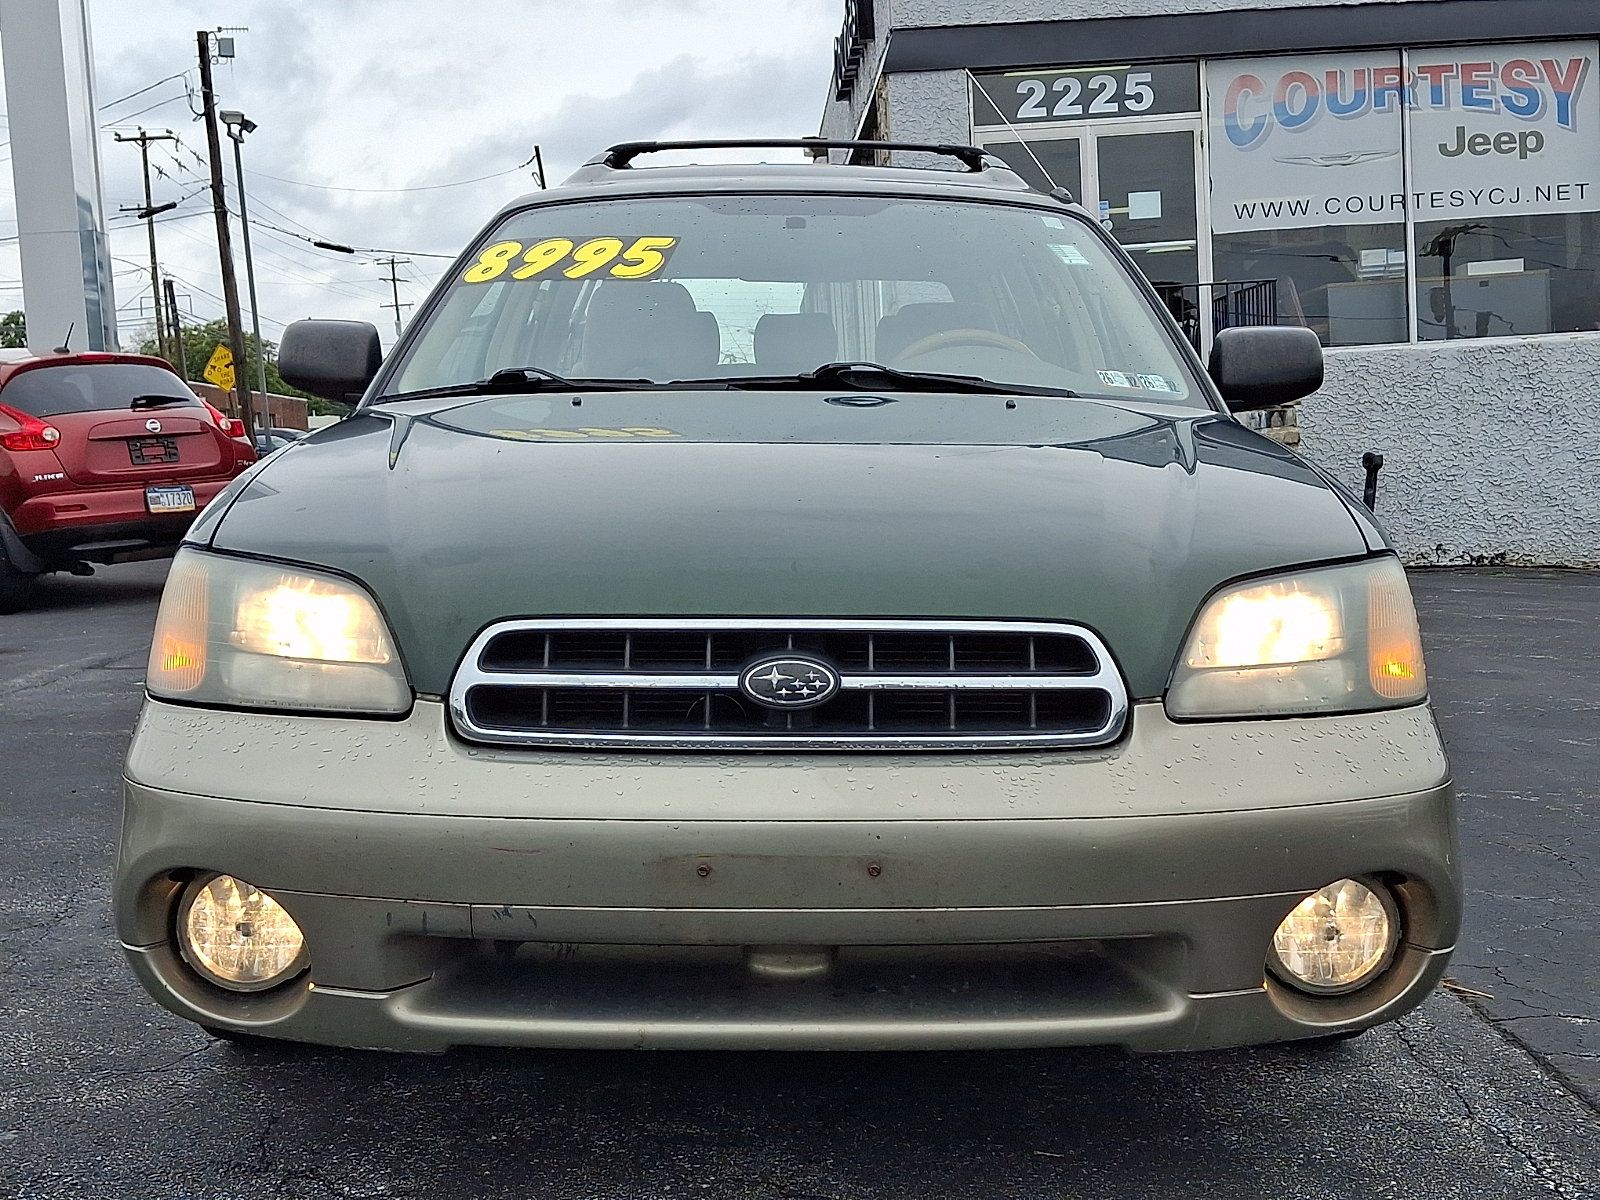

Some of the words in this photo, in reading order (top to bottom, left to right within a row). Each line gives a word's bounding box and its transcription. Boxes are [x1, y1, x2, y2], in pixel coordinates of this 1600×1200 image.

[1016, 72, 1155, 119] 2225
[1223, 57, 1587, 151] COURTESY
[1438, 126, 1544, 159] Jeep
[1233, 183, 1590, 219] WWW.COURTESYCJ.NET
[463, 236, 676, 283] 8995
